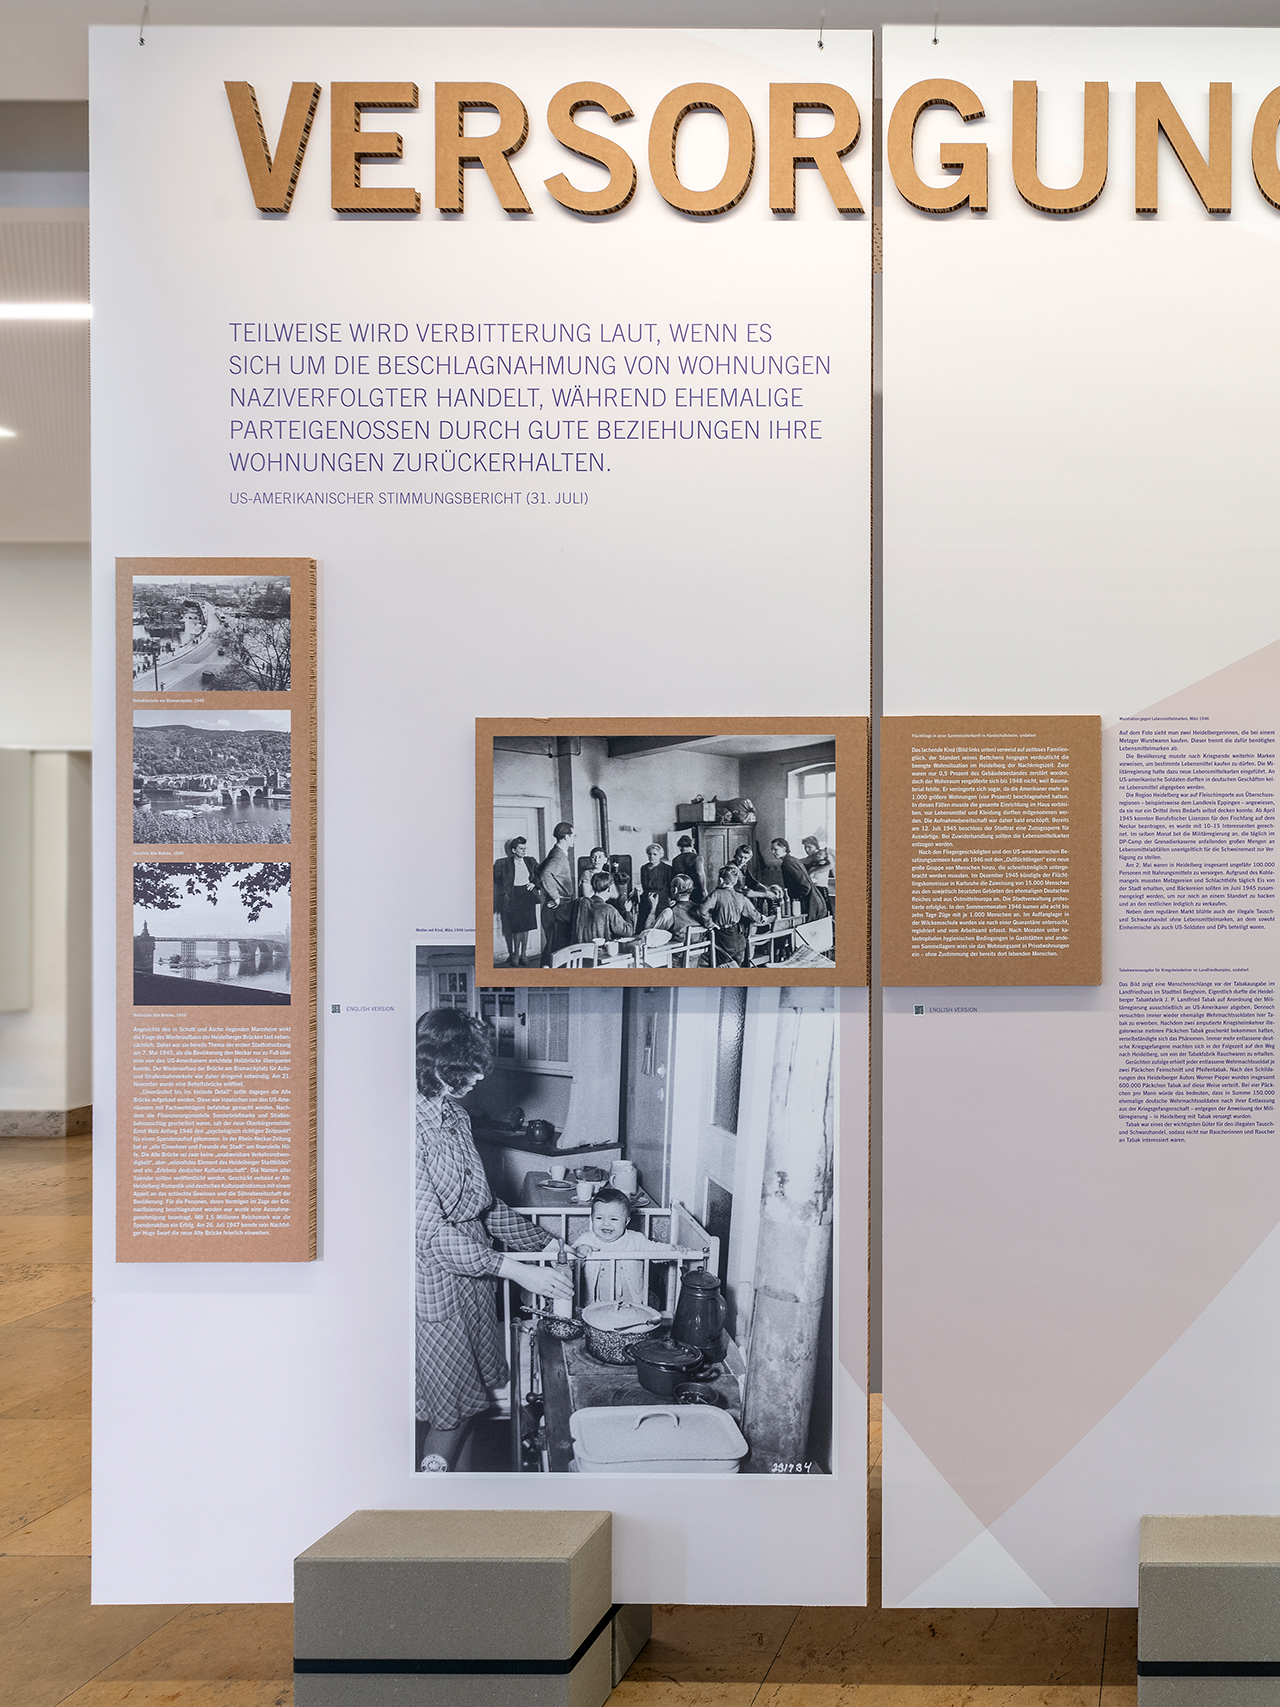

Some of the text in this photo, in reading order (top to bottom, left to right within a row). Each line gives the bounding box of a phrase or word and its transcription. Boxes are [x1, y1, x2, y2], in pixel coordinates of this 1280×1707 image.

[229, 323, 772, 346] TEILWEISE WIRD VERBITTERUNG LAUT, WENN ES
[229, 355, 830, 375] SICH UM DIE BESCHLAGNAHMUNG VON WOHNUNGEN
[231, 385, 803, 411] NAZIVERFOLGTER HANDELT, WÄHREND EHEMALIGE
[231, 420, 822, 440] PARTEIGENOSSEN DURCH GUTE BEZIEHUNGEN IHRE
[229, 449, 610, 472] WOHNUNGEN ZURÜCKERHALTEN.
[230, 492, 588, 505] US-AMERIKANISCHER STIMMUNGSBERICHT (31. JULI)
